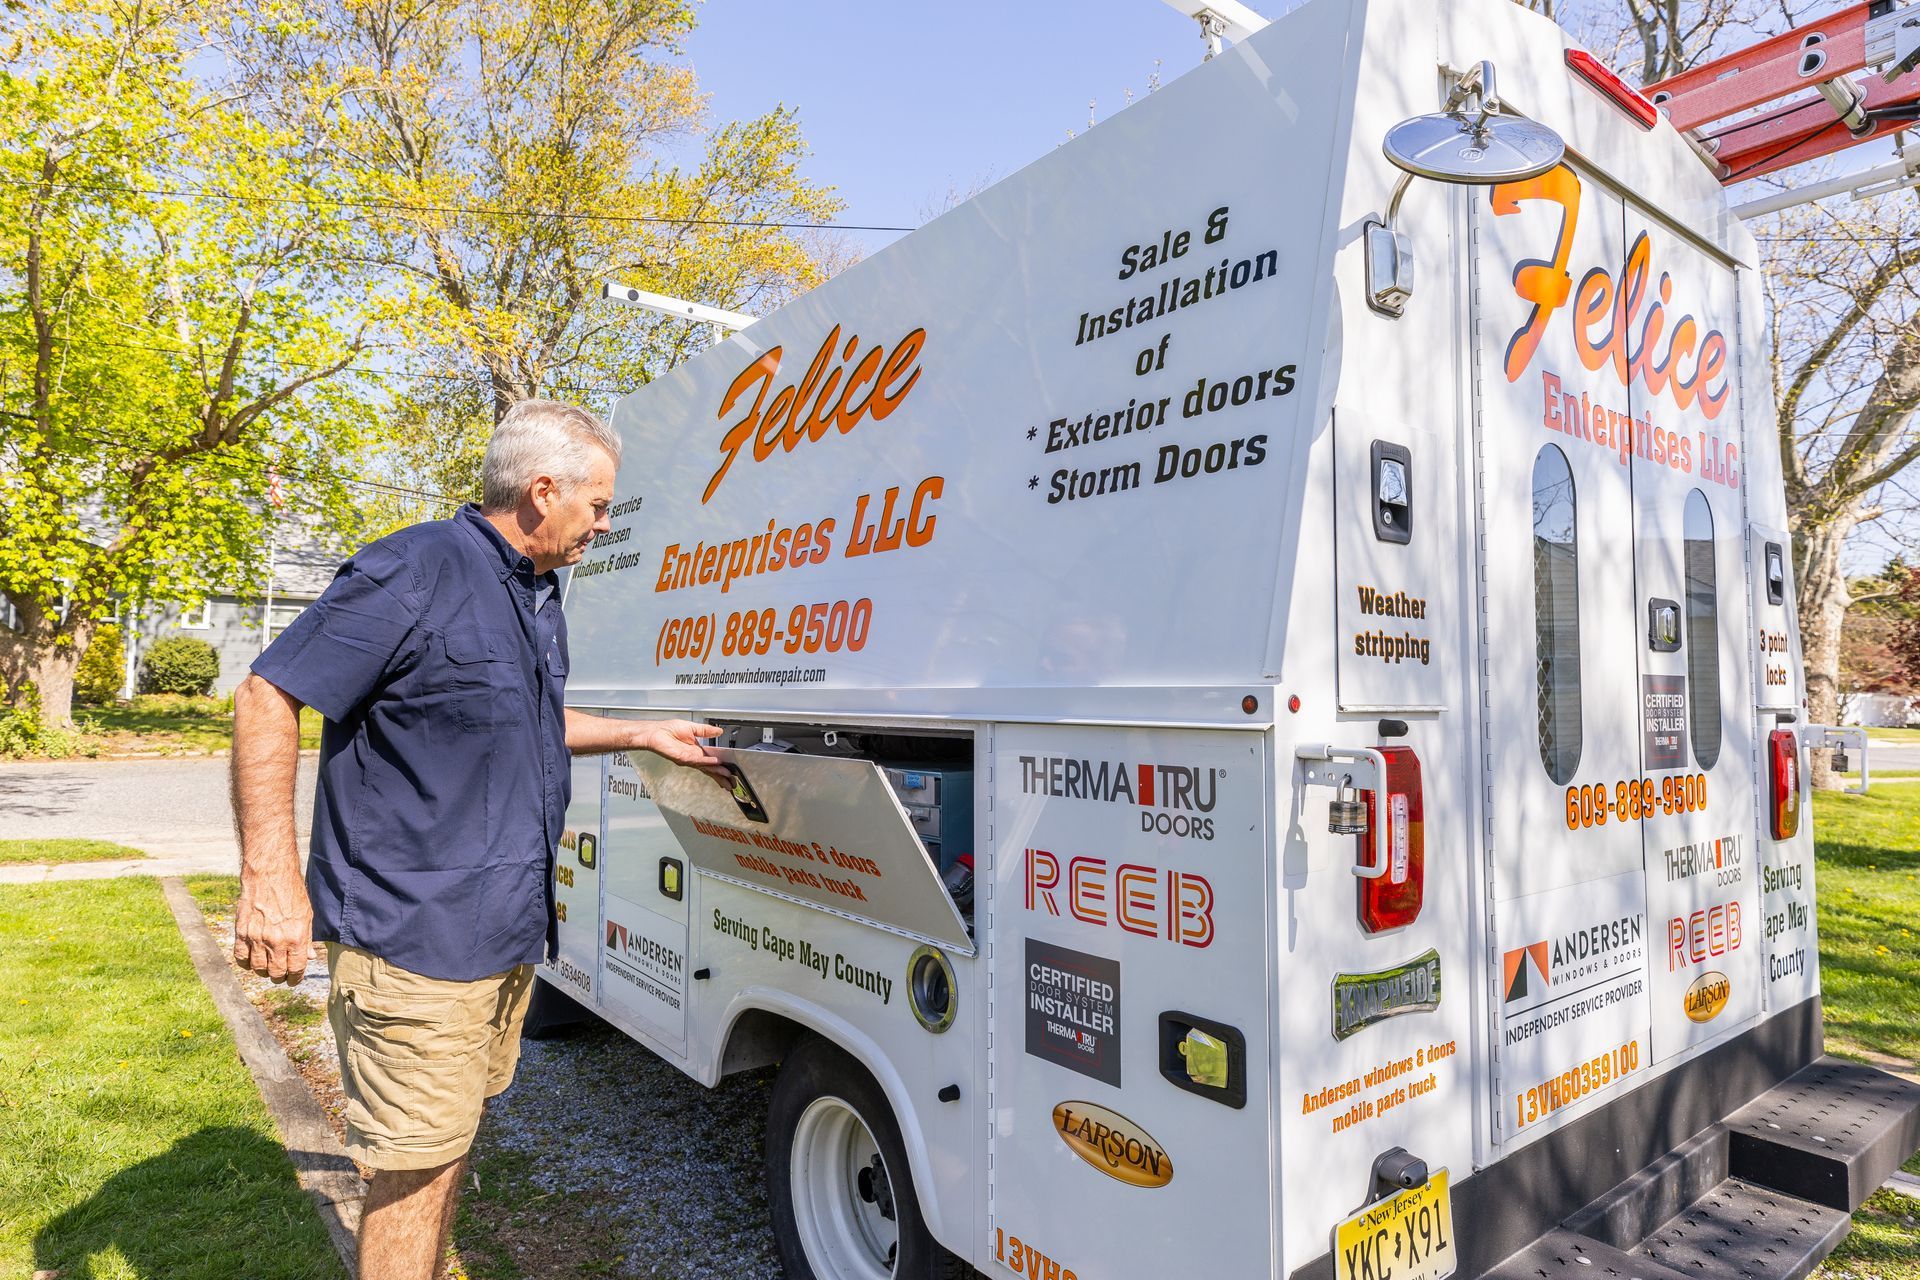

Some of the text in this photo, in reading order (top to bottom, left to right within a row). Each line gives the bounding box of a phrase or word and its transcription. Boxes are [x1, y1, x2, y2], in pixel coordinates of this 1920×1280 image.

[1118, 206, 1230, 281] Sale &
[1075, 249, 1278, 347] Installation
[1490, 162, 1731, 421] Felice
[1135, 333, 1171, 376] of
[701, 322, 927, 506] Felice
[1044, 364, 1297, 454] Exterior doors
[1542, 370, 1739, 490] Enterprises LLC
[1047, 435, 1268, 504] Storm Doors
[610, 496, 643, 519] service
[655, 476, 945, 594] Enterprises LLC
[572, 552, 641, 580] windows & doors
[1357, 585, 1426, 620] Weather
[656, 598, 873, 667] (609) 889-9500
[1355, 630, 1430, 666] stripping
[1759, 629, 1788, 660] 3 point
[675, 665, 826, 688] www.avalondoorwindowrepair.com
[1766, 663, 1787, 687] locks
[1645, 693, 1684, 708] CERTIFIED
[1646, 708, 1684, 717] DOOR SYSTEM
[1646, 718, 1685, 733] INSTALLER
[608, 774, 638, 801] Factory
[1019, 756, 1135, 804] THERMA
[1565, 773, 1707, 831] 609-889-9500
[690, 815, 882, 877] Andersen windows & doors
[1141, 811, 1215, 841] DOORS
[734, 853, 868, 902] mobile parts truck
[1664, 840, 1716, 882] THERMA
[1717, 867, 1742, 887] DOORS
[1764, 860, 1802, 894] Serving
[1025, 848, 1215, 949] REEB
[1552, 913, 1642, 969] ANDERSEN
[1667, 901, 1742, 973] REEB
[1764, 901, 1808, 943] ape May
[628, 931, 682, 974] ANDERSEN
[713, 907, 893, 1005] Serving Cape May County
[1552, 948, 1642, 987] WINDOWS & DOORS
[1769, 947, 1805, 982] County
[560, 960, 591, 993] 3534608
[606, 959, 681, 1011] INDEPENDENT SERVICE PROVIDER
[662, 970, 681, 985] DOORS
[1030, 963, 1114, 1002] CERTIFIED
[1340, 959, 1437, 1032] KNAPHEIDE
[1687, 979, 1730, 1014] LARSON
[1030, 981, 1113, 1016] DOOR SYSTEM
[1030, 992, 1114, 1036] INSTALLER
[1505, 979, 1643, 1047] INDEPENDENT SERVICE PROVIDER
[1047, 1020, 1078, 1042] THERMA
[1077, 1042, 1095, 1054] DOORS
[1302, 1040, 1456, 1115] Andersen windows & doors
[1517, 1040, 1639, 1129] 13VH60359100
[1332, 1073, 1437, 1134] mobile parts truck
[1060, 1109, 1163, 1177] LARSON
[1366, 1190, 1424, 1231] New Jersey
